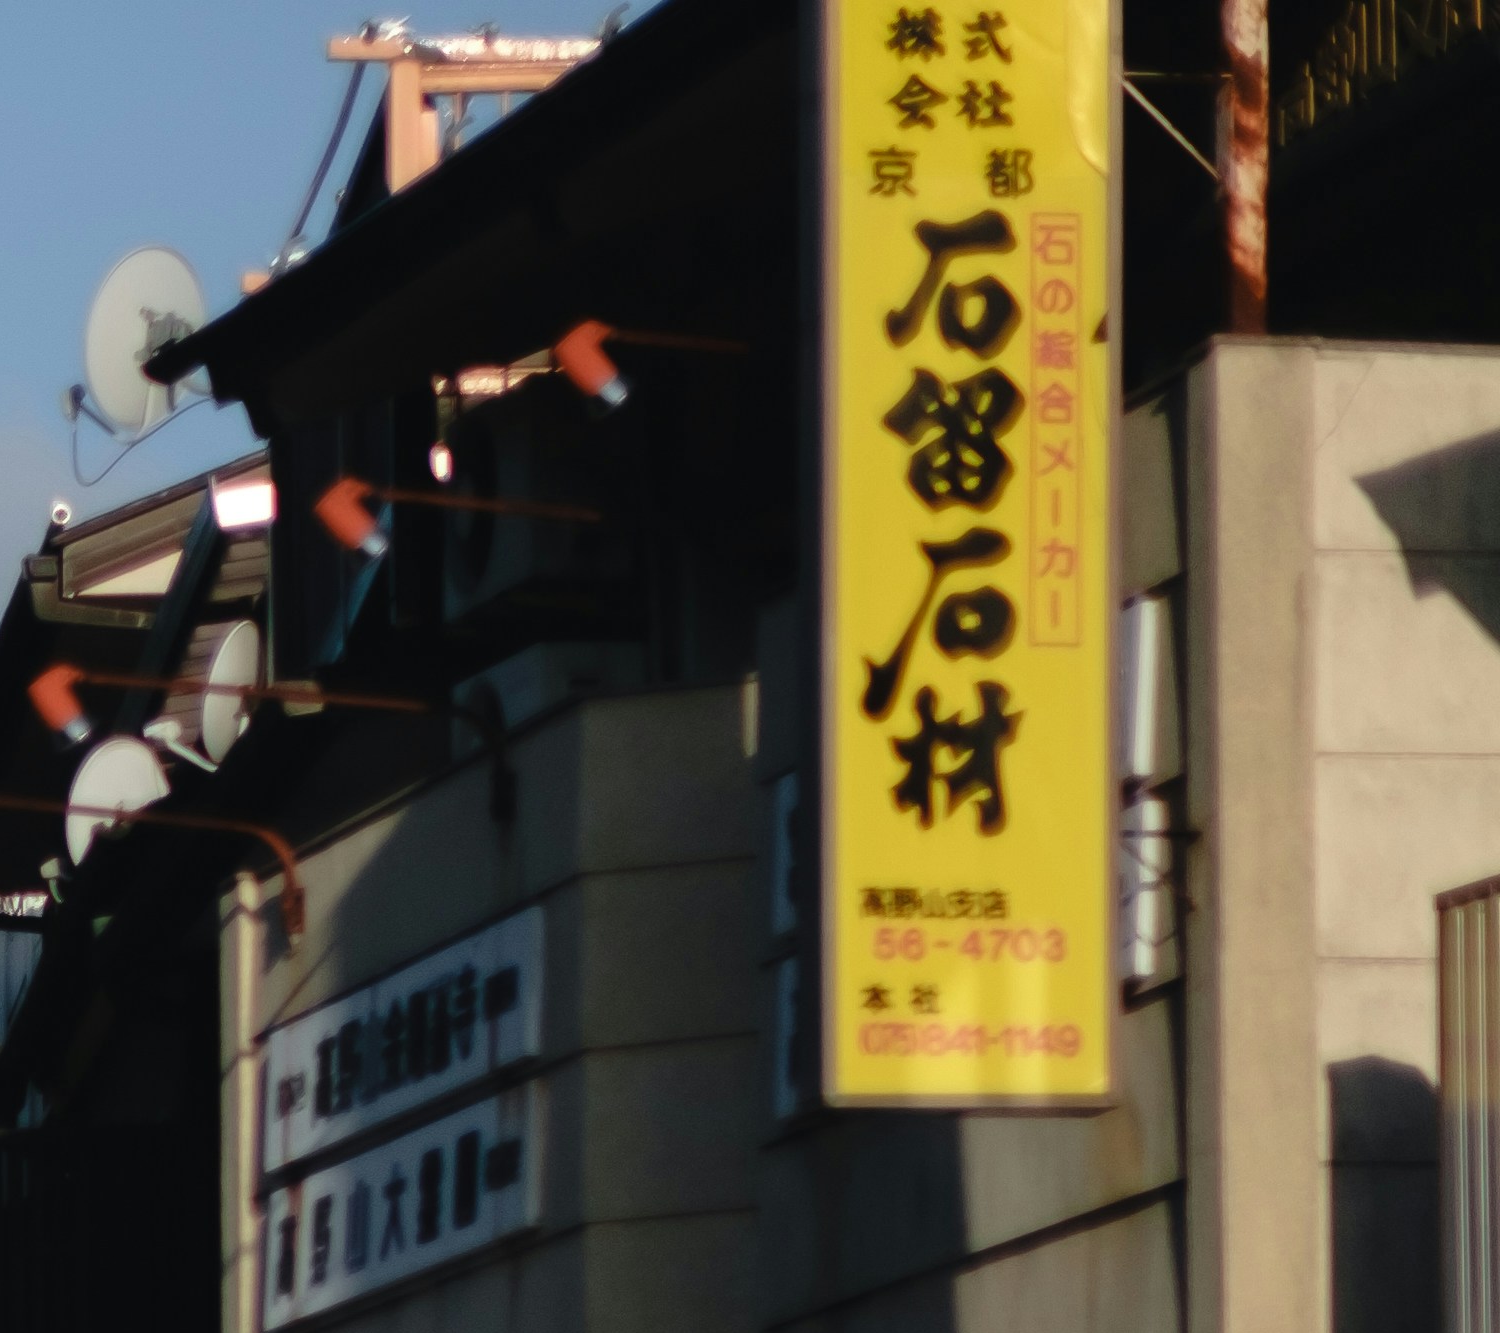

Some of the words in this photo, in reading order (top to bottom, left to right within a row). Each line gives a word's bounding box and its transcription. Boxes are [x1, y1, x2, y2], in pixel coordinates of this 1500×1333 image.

[885, 9, 1013, 63] 株式
[887, 74, 1014, 130] 会社
[867, 147, 1036, 197] 京都
[872, 927, 1067, 963] 56-4703
[861, 984, 940, 1014] 本社
